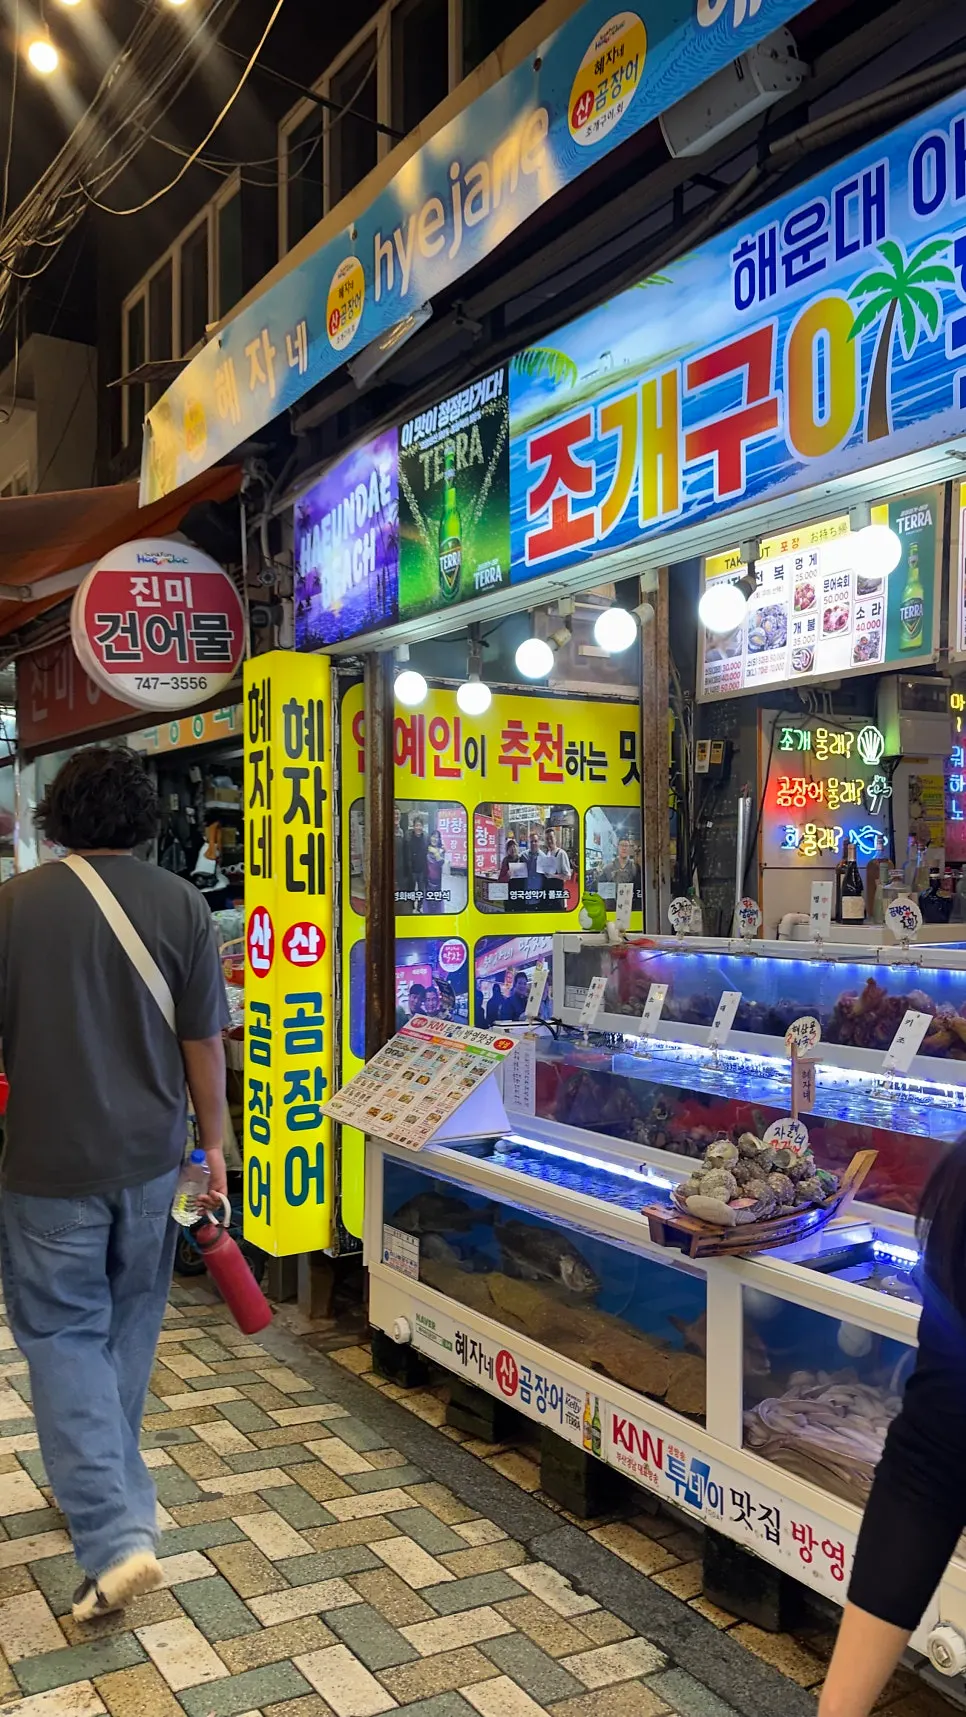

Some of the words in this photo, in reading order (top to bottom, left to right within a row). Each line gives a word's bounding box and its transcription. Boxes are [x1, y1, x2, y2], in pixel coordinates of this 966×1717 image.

[594, 44, 625, 75] 혜자네
[733, 164, 886, 311] 해운대
[300, 471, 391, 577] HAEUNDAE
[810, 523, 848, 543] お持ち帰
[896, 510, 932, 534] TERRA
[321, 527, 377, 610] BEACH
[438, 551, 463, 572] TERRA
[474, 564, 502, 590] TERRA
[725, 556, 742, 570] TAK
[130, 575, 193, 609] 진미
[823, 574, 850, 593] 문어숙회
[856, 602, 882, 620] 소라
[900, 604, 923, 621] TERRA
[94, 611, 234, 663] 건어물
[135, 676, 208, 690] 747-3556
[498, 720, 608, 783] 추천하는
[780, 728, 811, 751] 조개
[248, 677, 273, 879] 혜자네
[777, 776, 824, 808] 곰장어
[282, 697, 328, 895] 혜자네
[781, 825, 800, 849] 회
[250, 912, 272, 969] 산
[287, 925, 321, 961] 산
[248, 1001, 273, 1227] 곰장어
[283, 992, 328, 1207] 곰장어
[455, 1330, 494, 1381] 혜자네
[519, 1365, 564, 1425] 곰장어
[565, 1397, 581, 1415] Kelly
[612, 1413, 664, 1471] KNN
[664, 1454, 725, 1516] 투데이
[729, 1487, 781, 1546] 맛집
[790, 1520, 846, 1582] 방영
